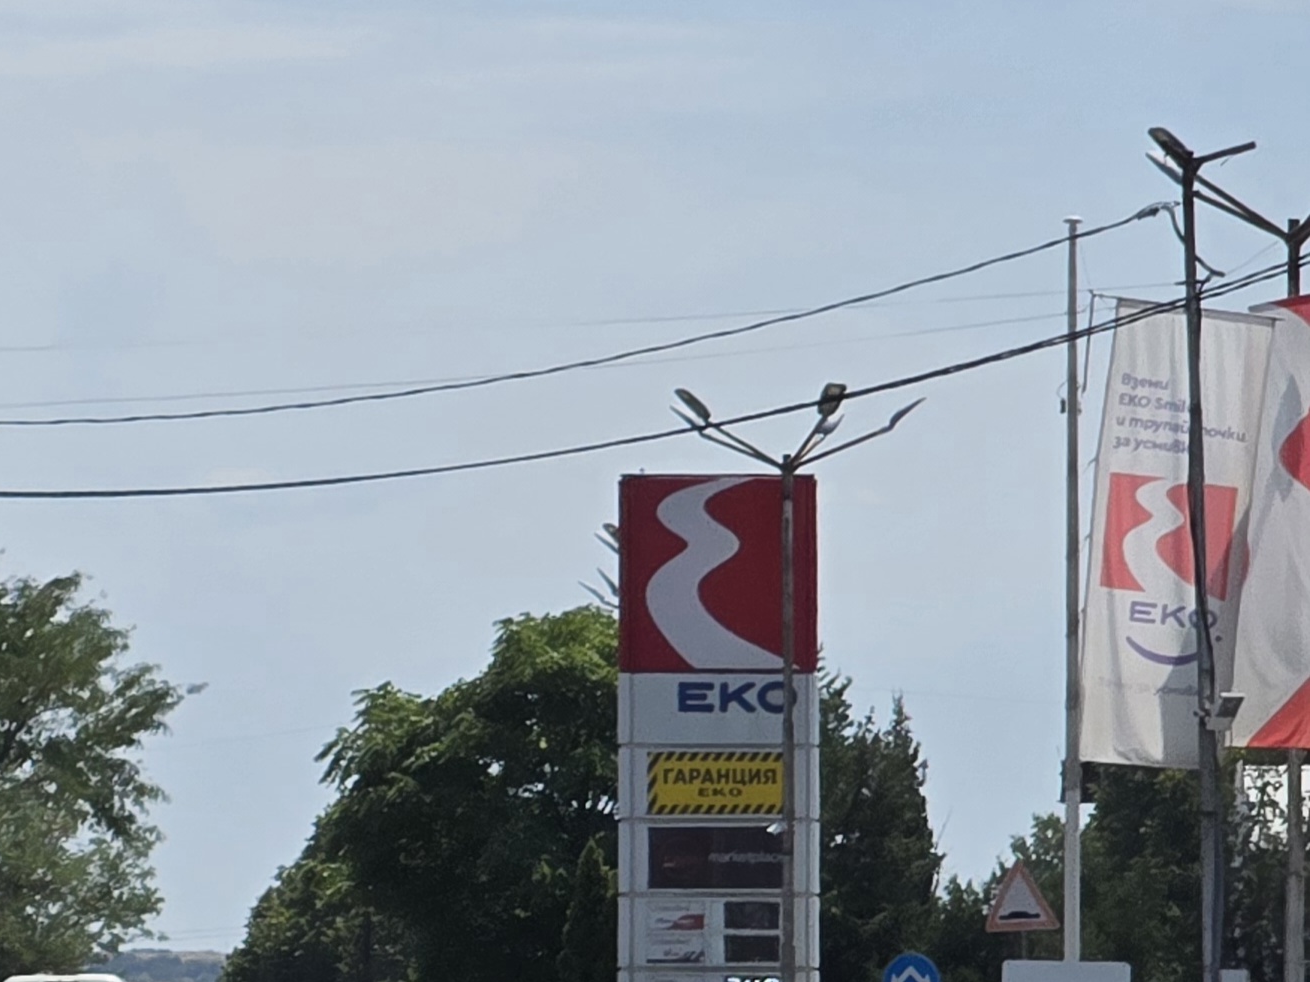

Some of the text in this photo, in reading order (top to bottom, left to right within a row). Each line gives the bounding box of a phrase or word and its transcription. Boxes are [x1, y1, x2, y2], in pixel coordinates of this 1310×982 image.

[1121, 372, 1169, 390] Вземи
[1119, 392, 1188, 413] EKO Smil
[1133, 438, 1188, 453] усмив
[1129, 600, 1218, 629] EKO
[677, 681, 797, 713] EKO
[663, 768, 778, 786] ГАРАНЦИЯ
